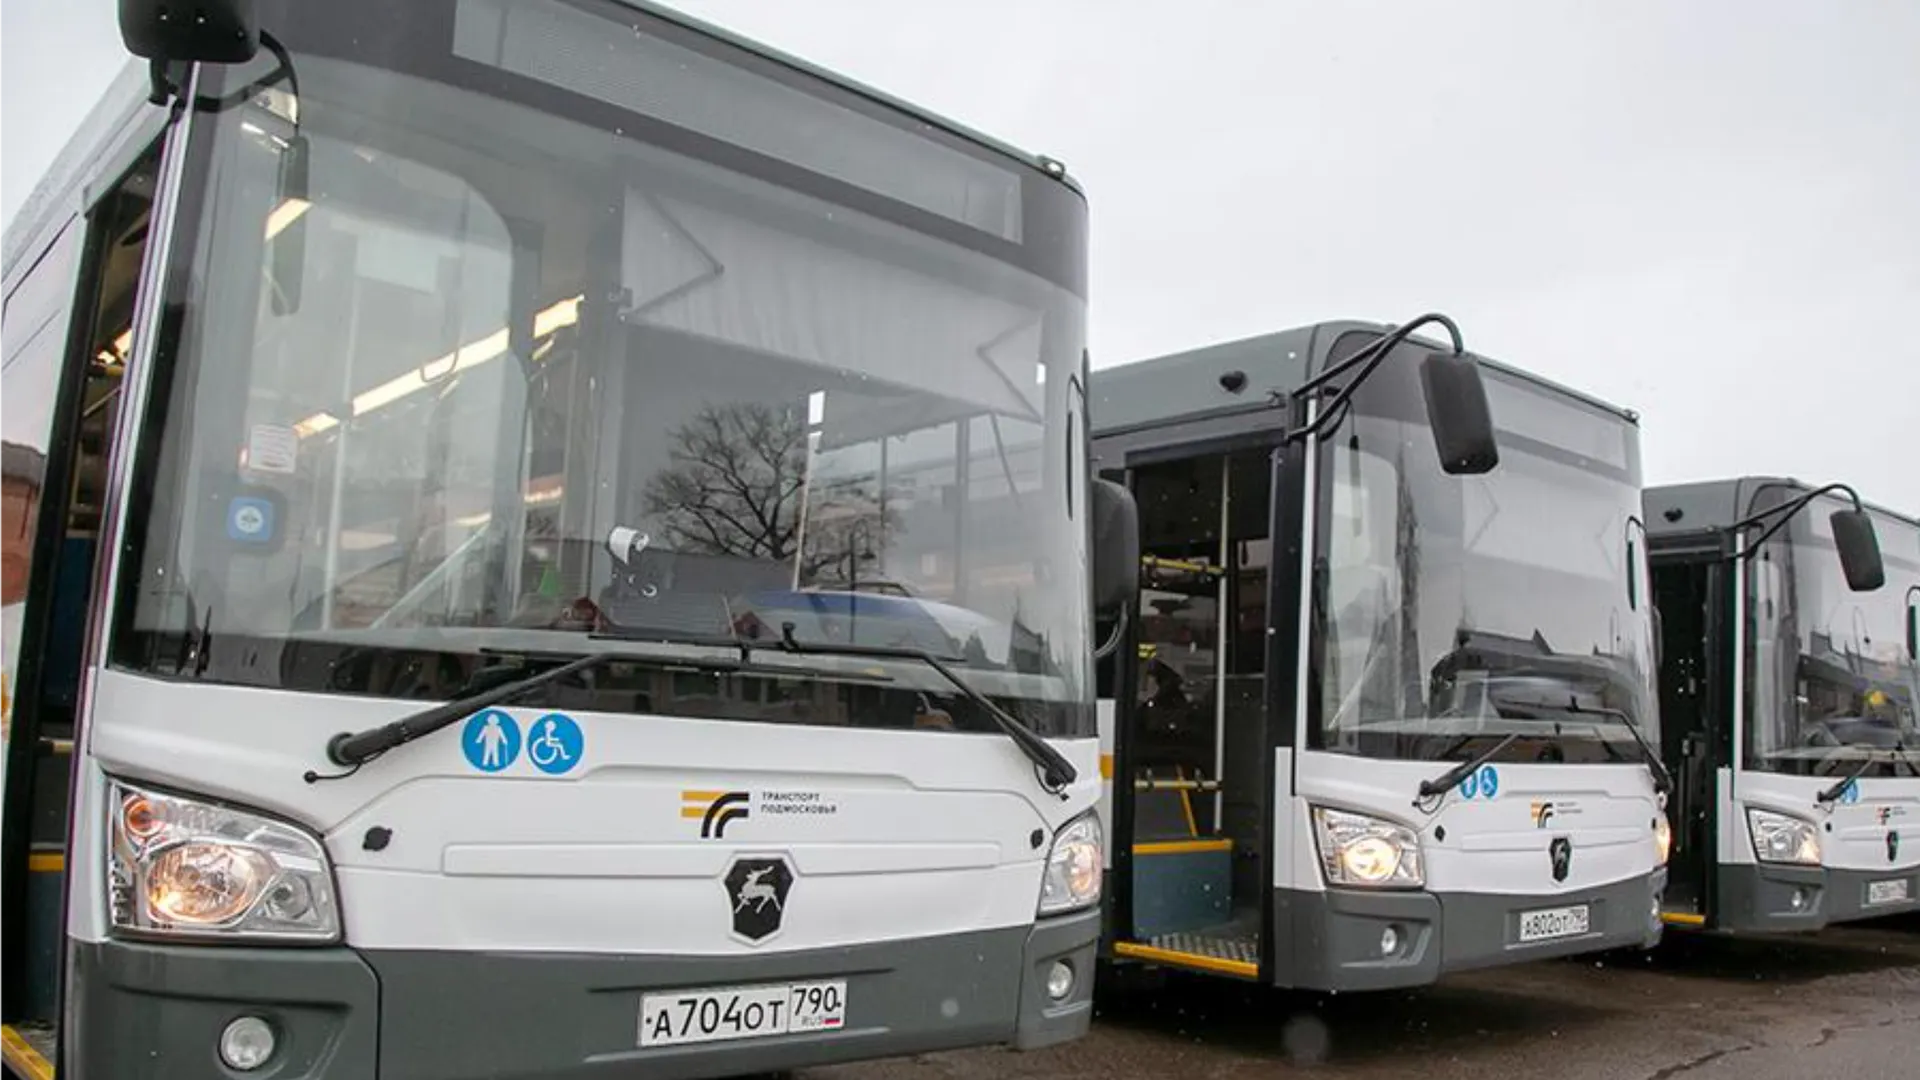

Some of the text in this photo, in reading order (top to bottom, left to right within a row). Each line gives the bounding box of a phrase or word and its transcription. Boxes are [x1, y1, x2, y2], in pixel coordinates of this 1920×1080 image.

[762, 792, 820, 802] ТРАНСПОРТ
[760, 804, 837, 814] ПОДМОСКОВЬЯ
[793, 986, 839, 1016] 790
